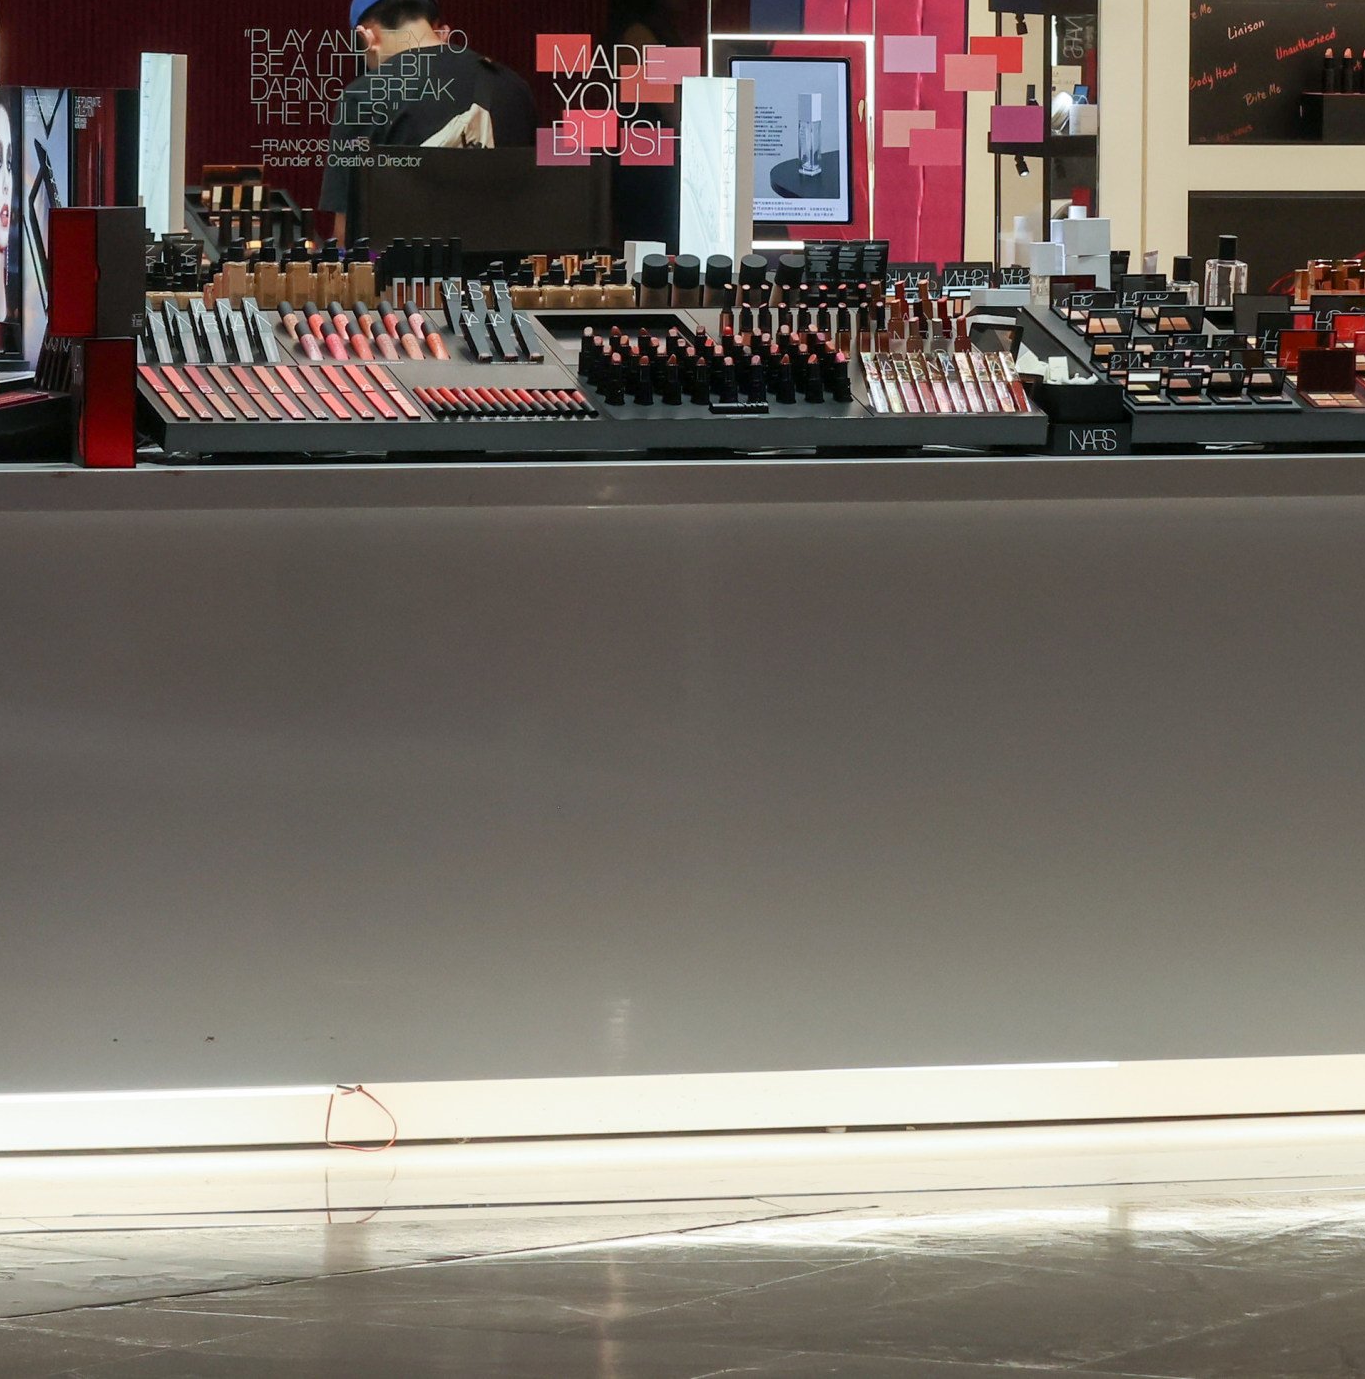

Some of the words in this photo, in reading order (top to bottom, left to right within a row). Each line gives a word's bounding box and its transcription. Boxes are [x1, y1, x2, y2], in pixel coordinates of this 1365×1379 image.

[318, 28, 373, 53] AND
[433, 29, 468, 54] TO
[1227, 18, 1265, 41] Liaison
[250, 53, 282, 77] BE
[289, 53, 310, 77] A
[316, 53, 394, 77] LITTLE
[400, 53, 437, 77] BIT
[552, 44, 668, 81] MADE
[552, 81, 641, 120] YOU
[250, 101, 301, 125] THE
[332, 137, 371, 153] NARS
[552, 120, 683, 158] BLUSH
[262, 154, 312, 168] Founder
[315, 154, 325, 168] &
[327, 154, 375, 168] Creative
[377, 154, 423, 168] Director
[1069, 428, 1117, 451] NARS
